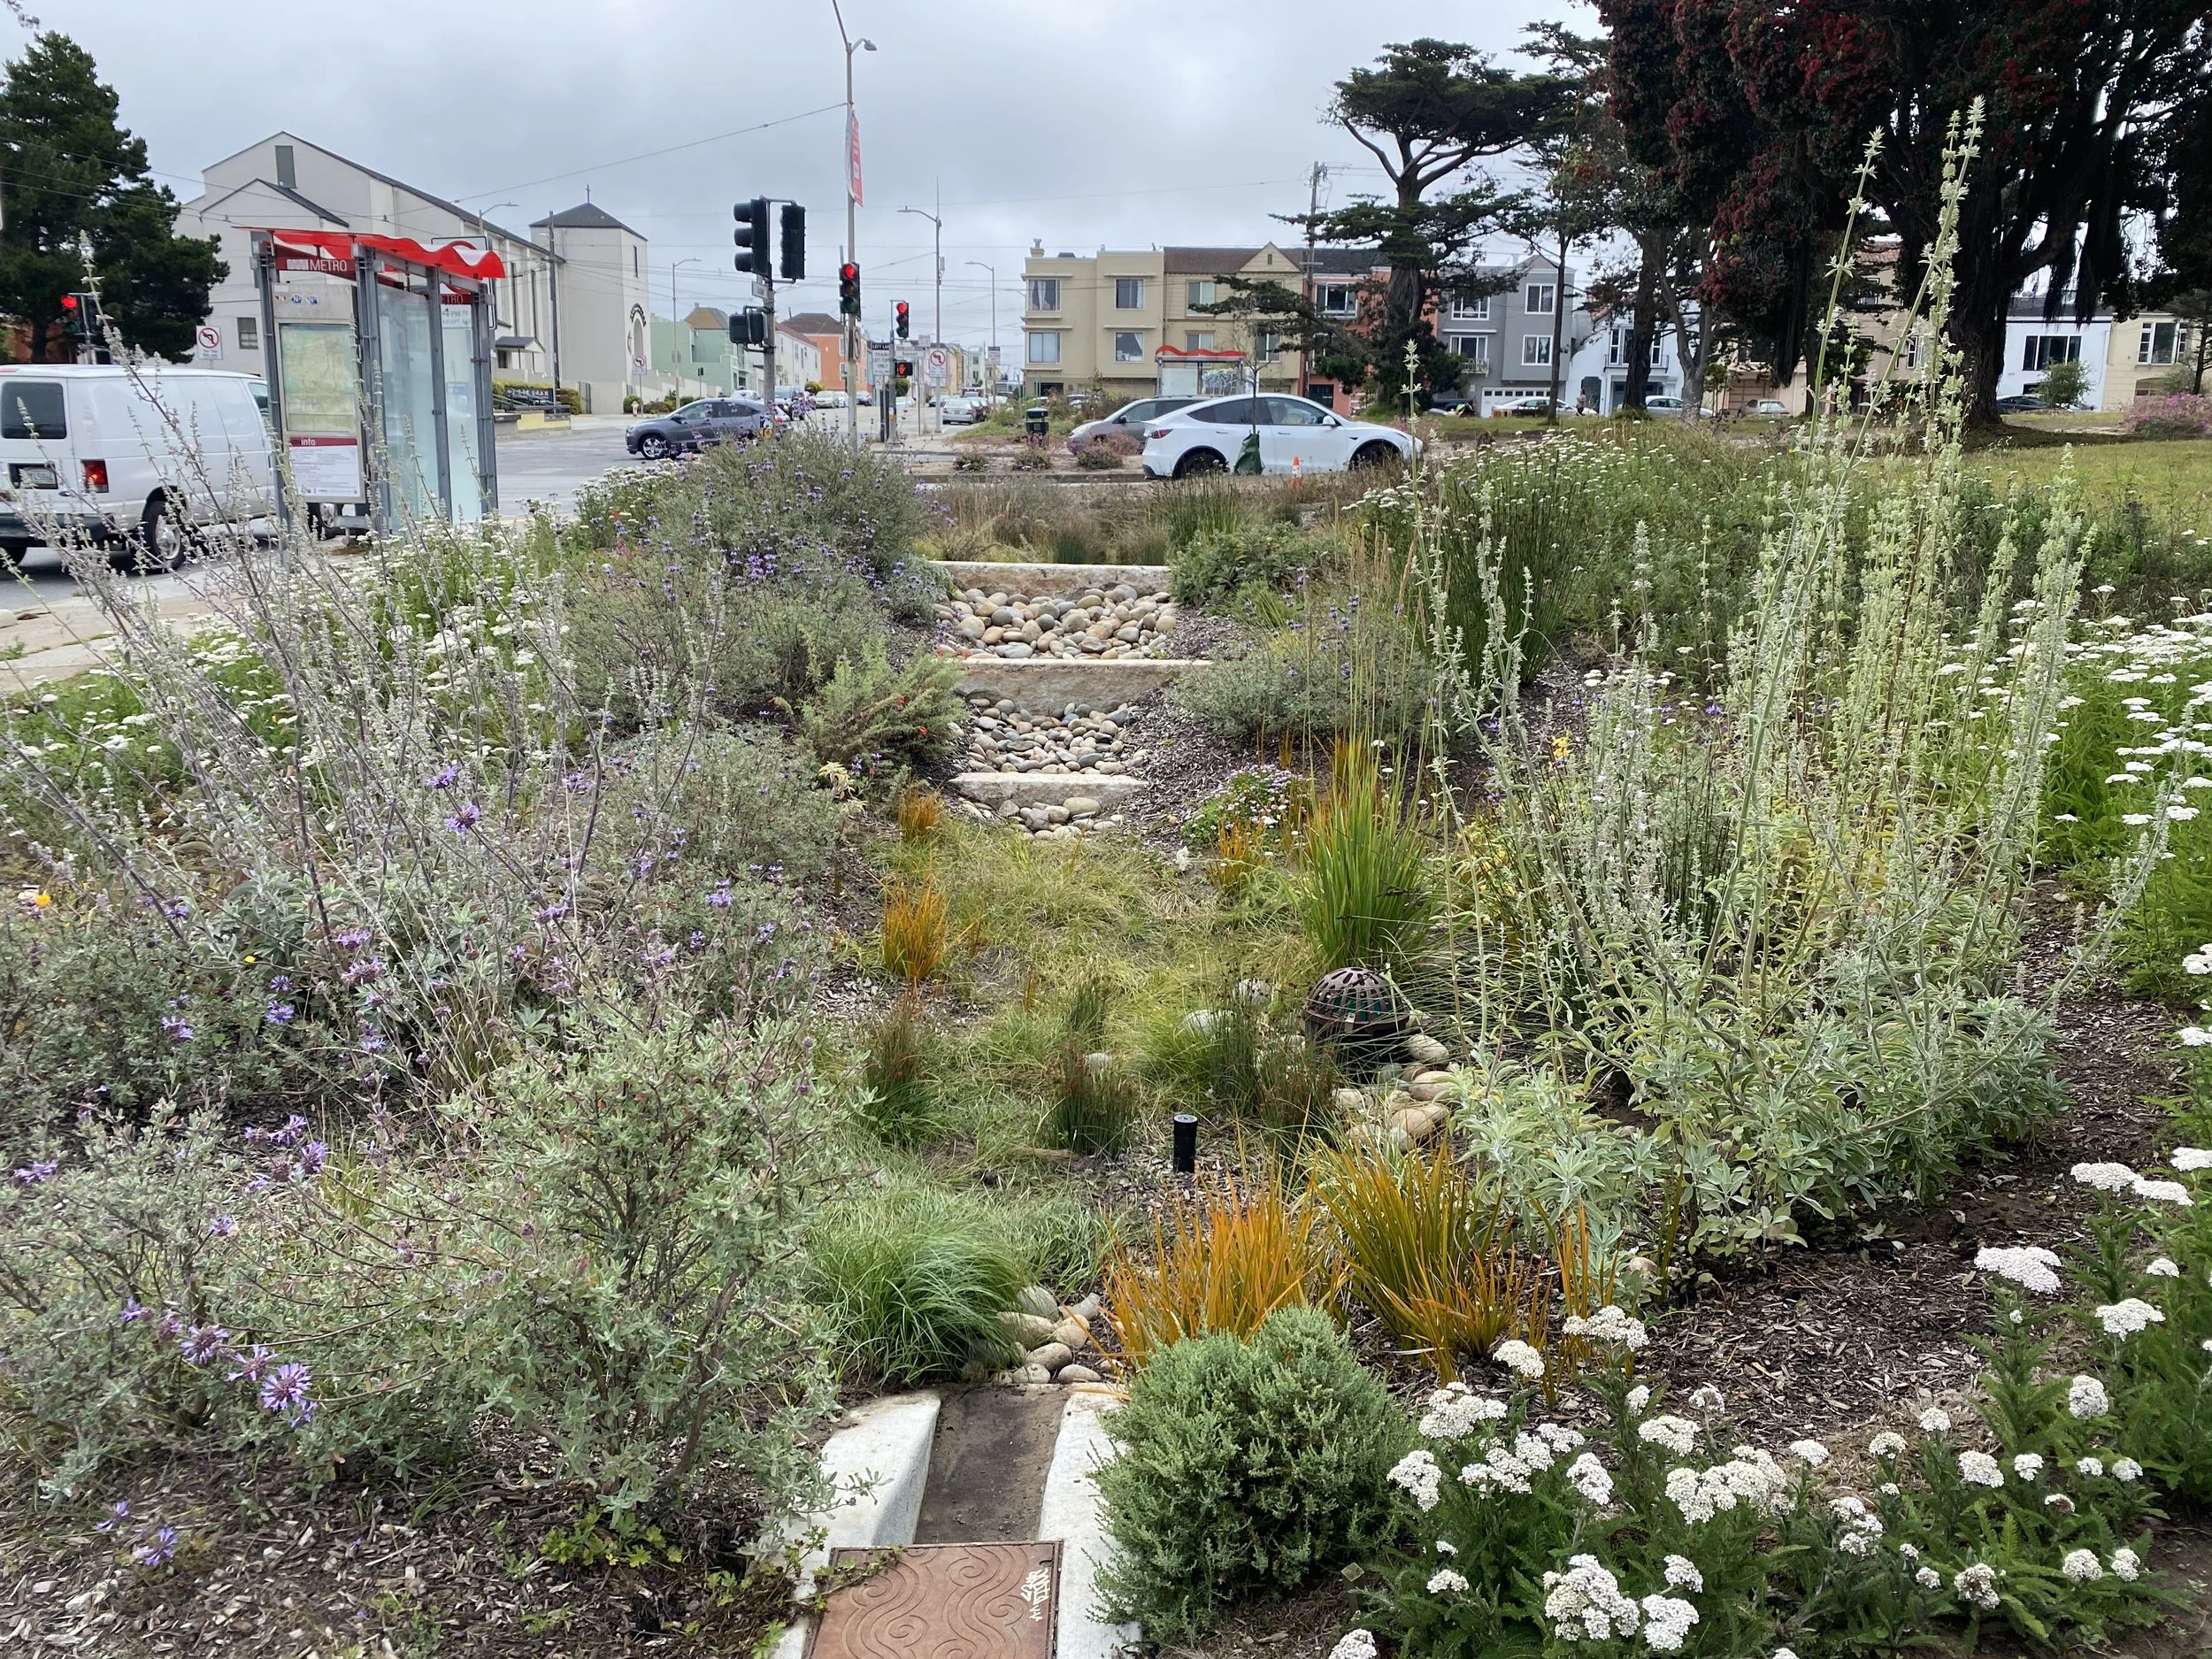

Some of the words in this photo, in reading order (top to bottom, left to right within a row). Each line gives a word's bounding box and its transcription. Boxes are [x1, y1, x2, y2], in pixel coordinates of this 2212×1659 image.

[310, 259, 347, 271] METRO
[441, 294, 464, 304] ETRO
[301, 436, 316, 446] info
